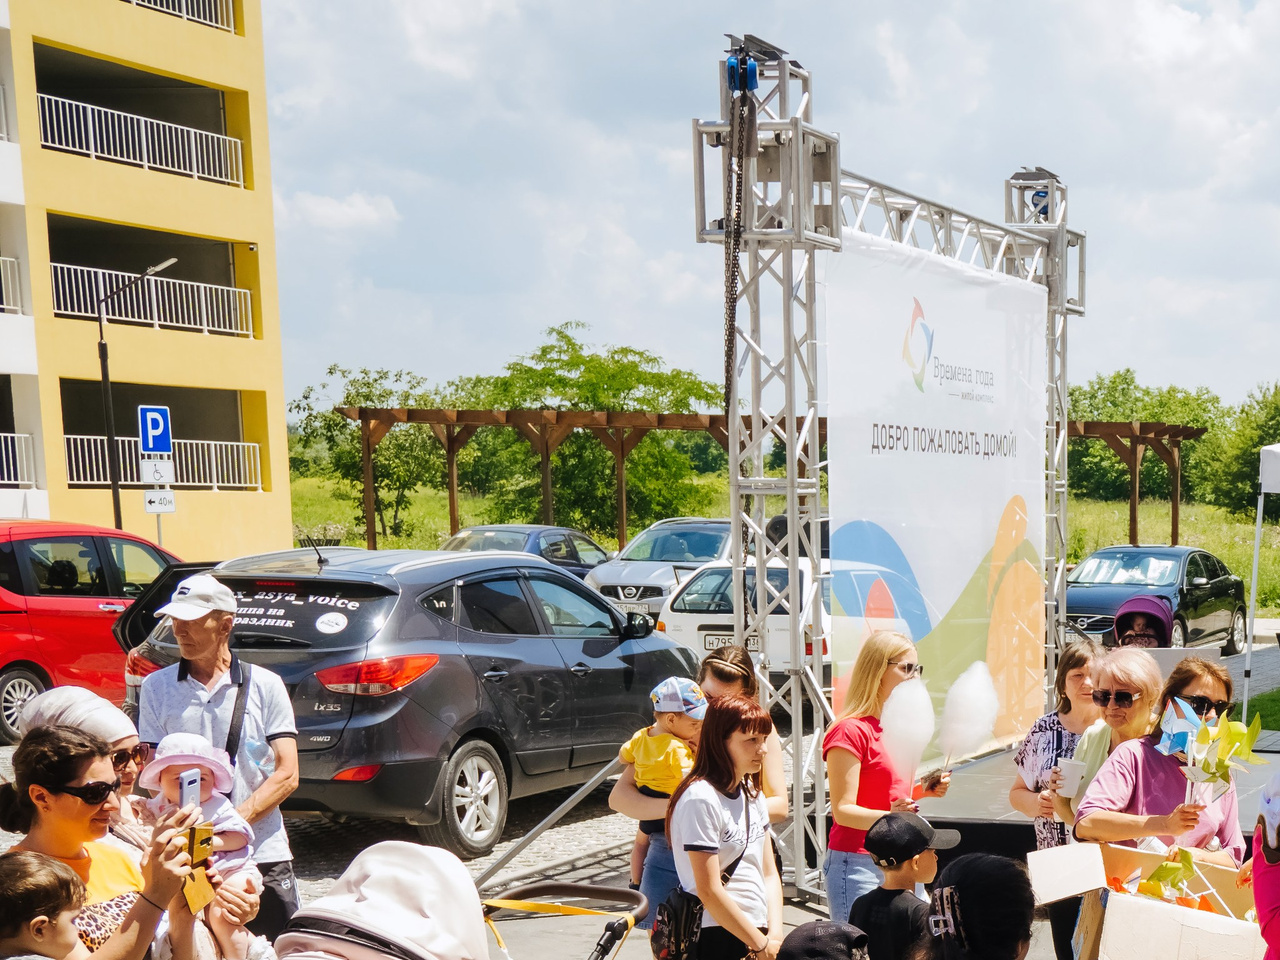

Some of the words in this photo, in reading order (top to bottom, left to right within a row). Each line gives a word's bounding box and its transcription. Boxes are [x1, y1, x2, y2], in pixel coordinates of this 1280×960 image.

[933, 356, 973, 386] Времена
[975, 369, 994, 389] года
[146, 411, 164, 449] P
[871, 423, 909, 454] ДОБРО
[913, 426, 981, 456] ПОЖАЛОВАТЬ
[982, 429, 1017, 461] ДОМОЙ!
[232, 616, 295, 628] раздник
[266, 607, 285, 616] на
